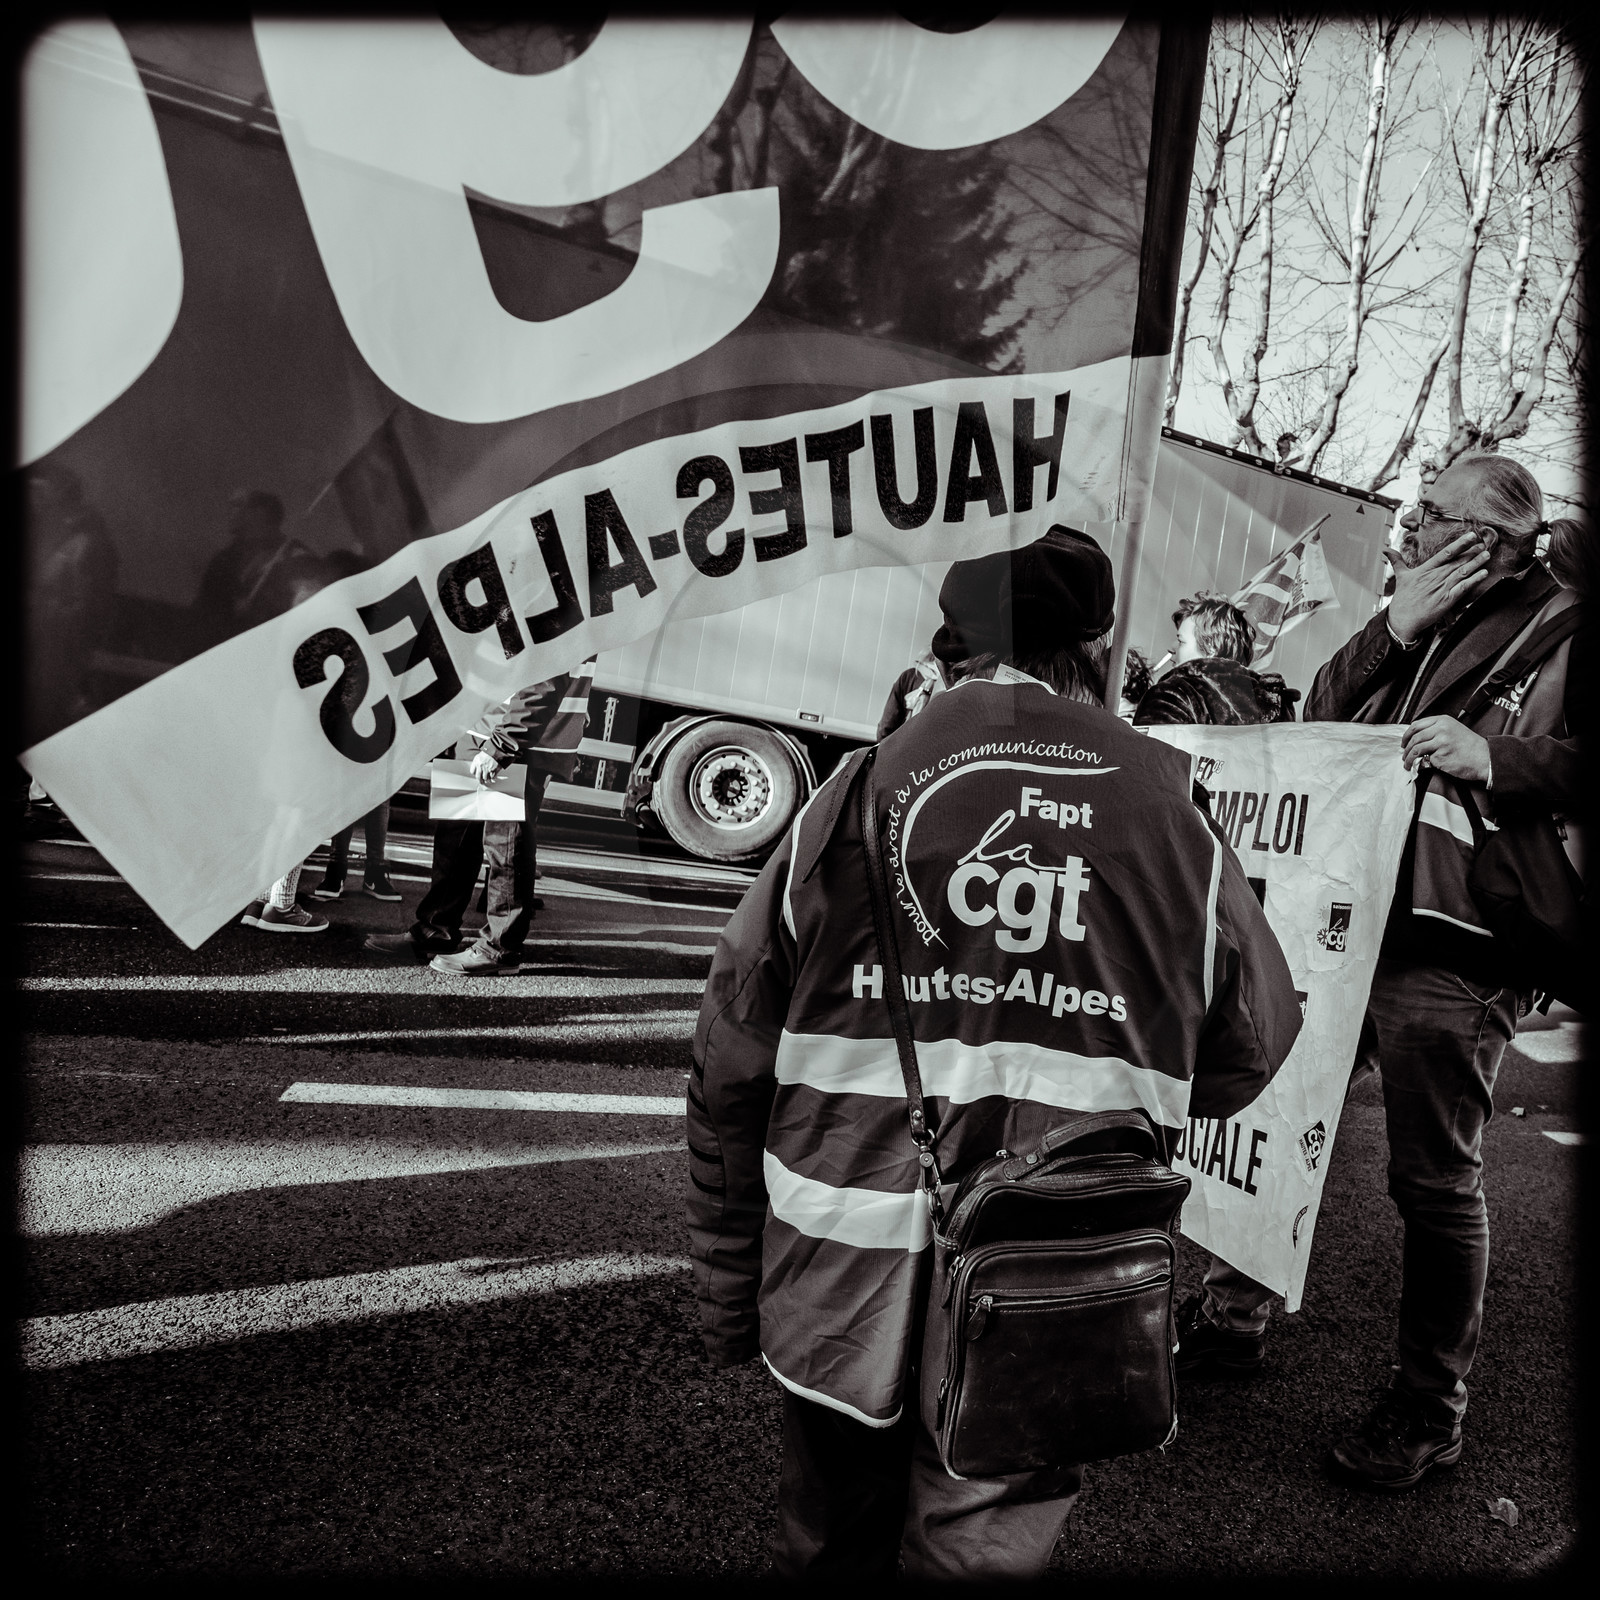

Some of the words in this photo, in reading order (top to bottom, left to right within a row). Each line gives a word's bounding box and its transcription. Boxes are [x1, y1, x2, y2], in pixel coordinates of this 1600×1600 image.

[909, 766, 935, 786] la
[938, 739, 1103, 771] communication
[1020, 786, 1093, 829] Fapt
[957, 809, 1091, 872] la
[901, 899, 940, 946] pour
[947, 855, 1091, 953] cgt
[1327, 930, 1347, 951] cg
[852, 964, 1127, 1022] Hutes-Alpes
